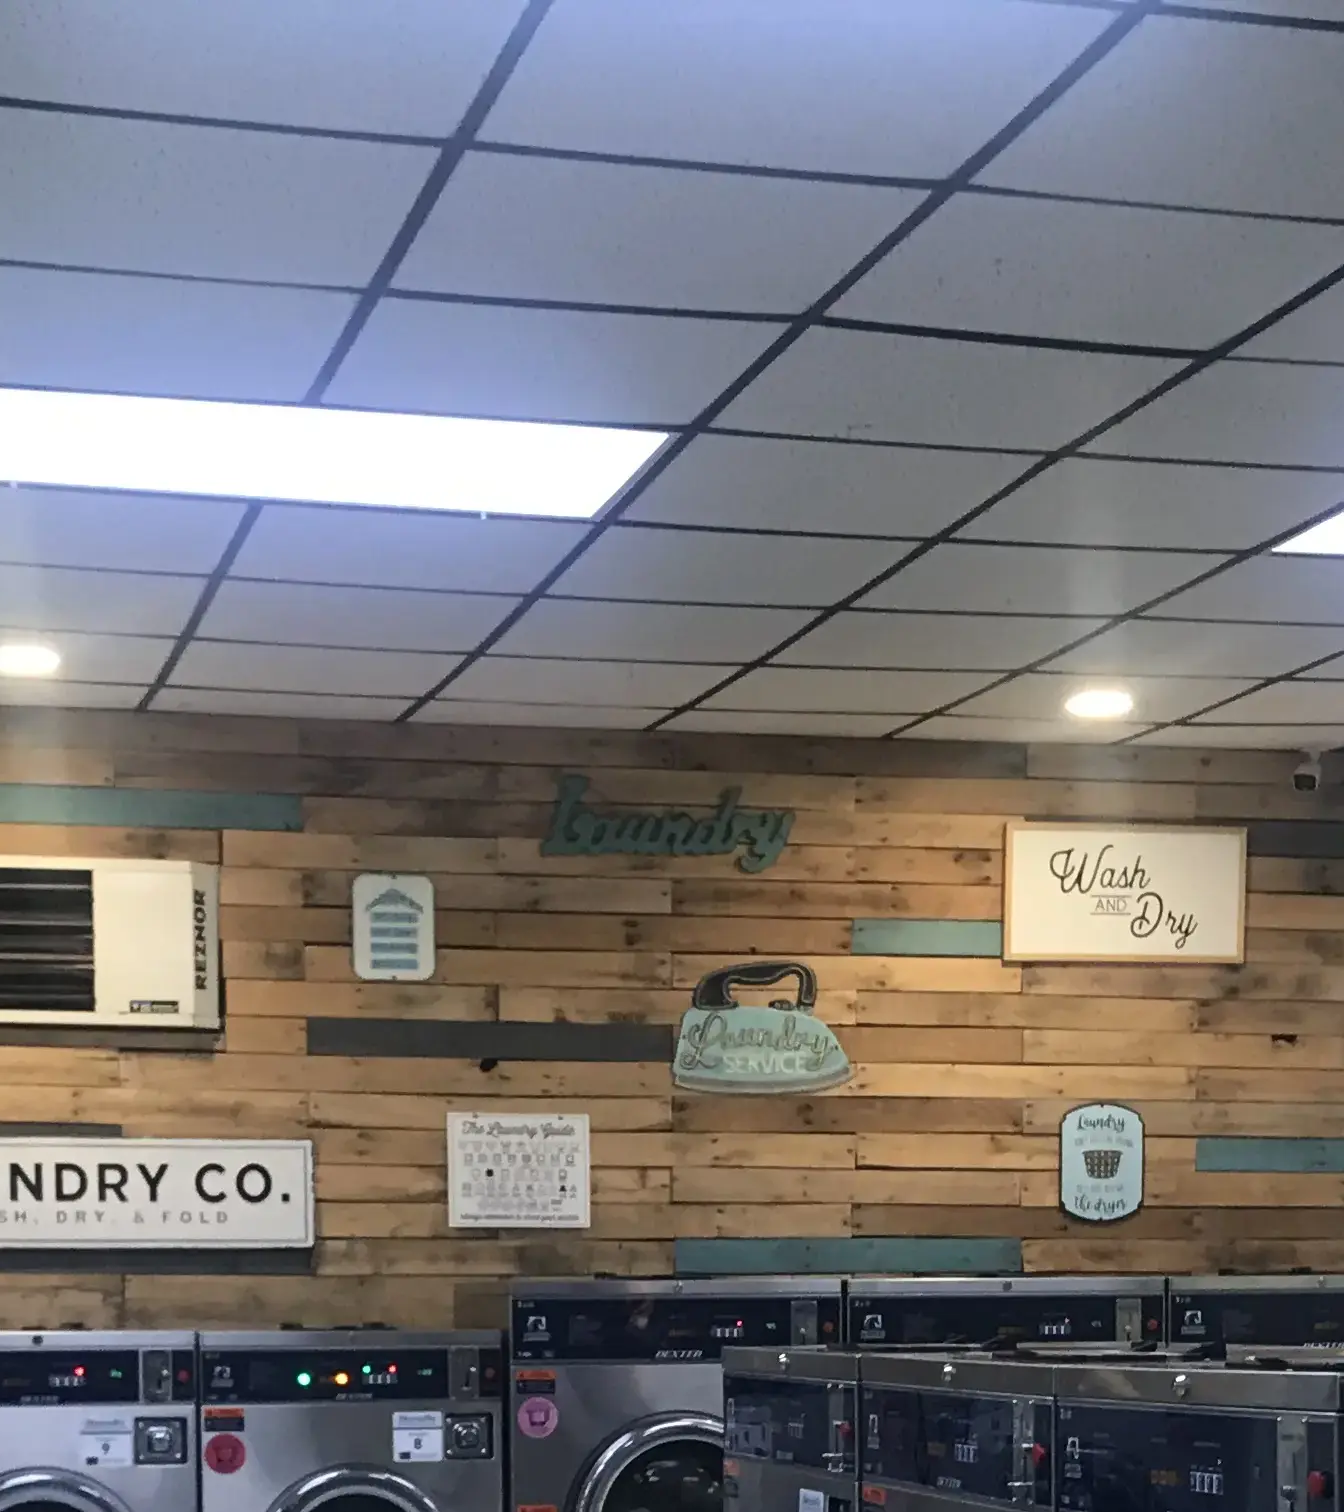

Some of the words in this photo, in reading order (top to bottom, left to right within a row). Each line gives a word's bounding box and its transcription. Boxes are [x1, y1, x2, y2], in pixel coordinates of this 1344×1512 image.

[1049, 844, 1151, 894] Wash
[1095, 898, 1127, 912] AND
[1130, 892, 1198, 950] Dry
[193, 888, 207, 990] REZNOR
[194, 1162, 291, 1204] CO.
[162, 1210, 229, 1224] FOLD
